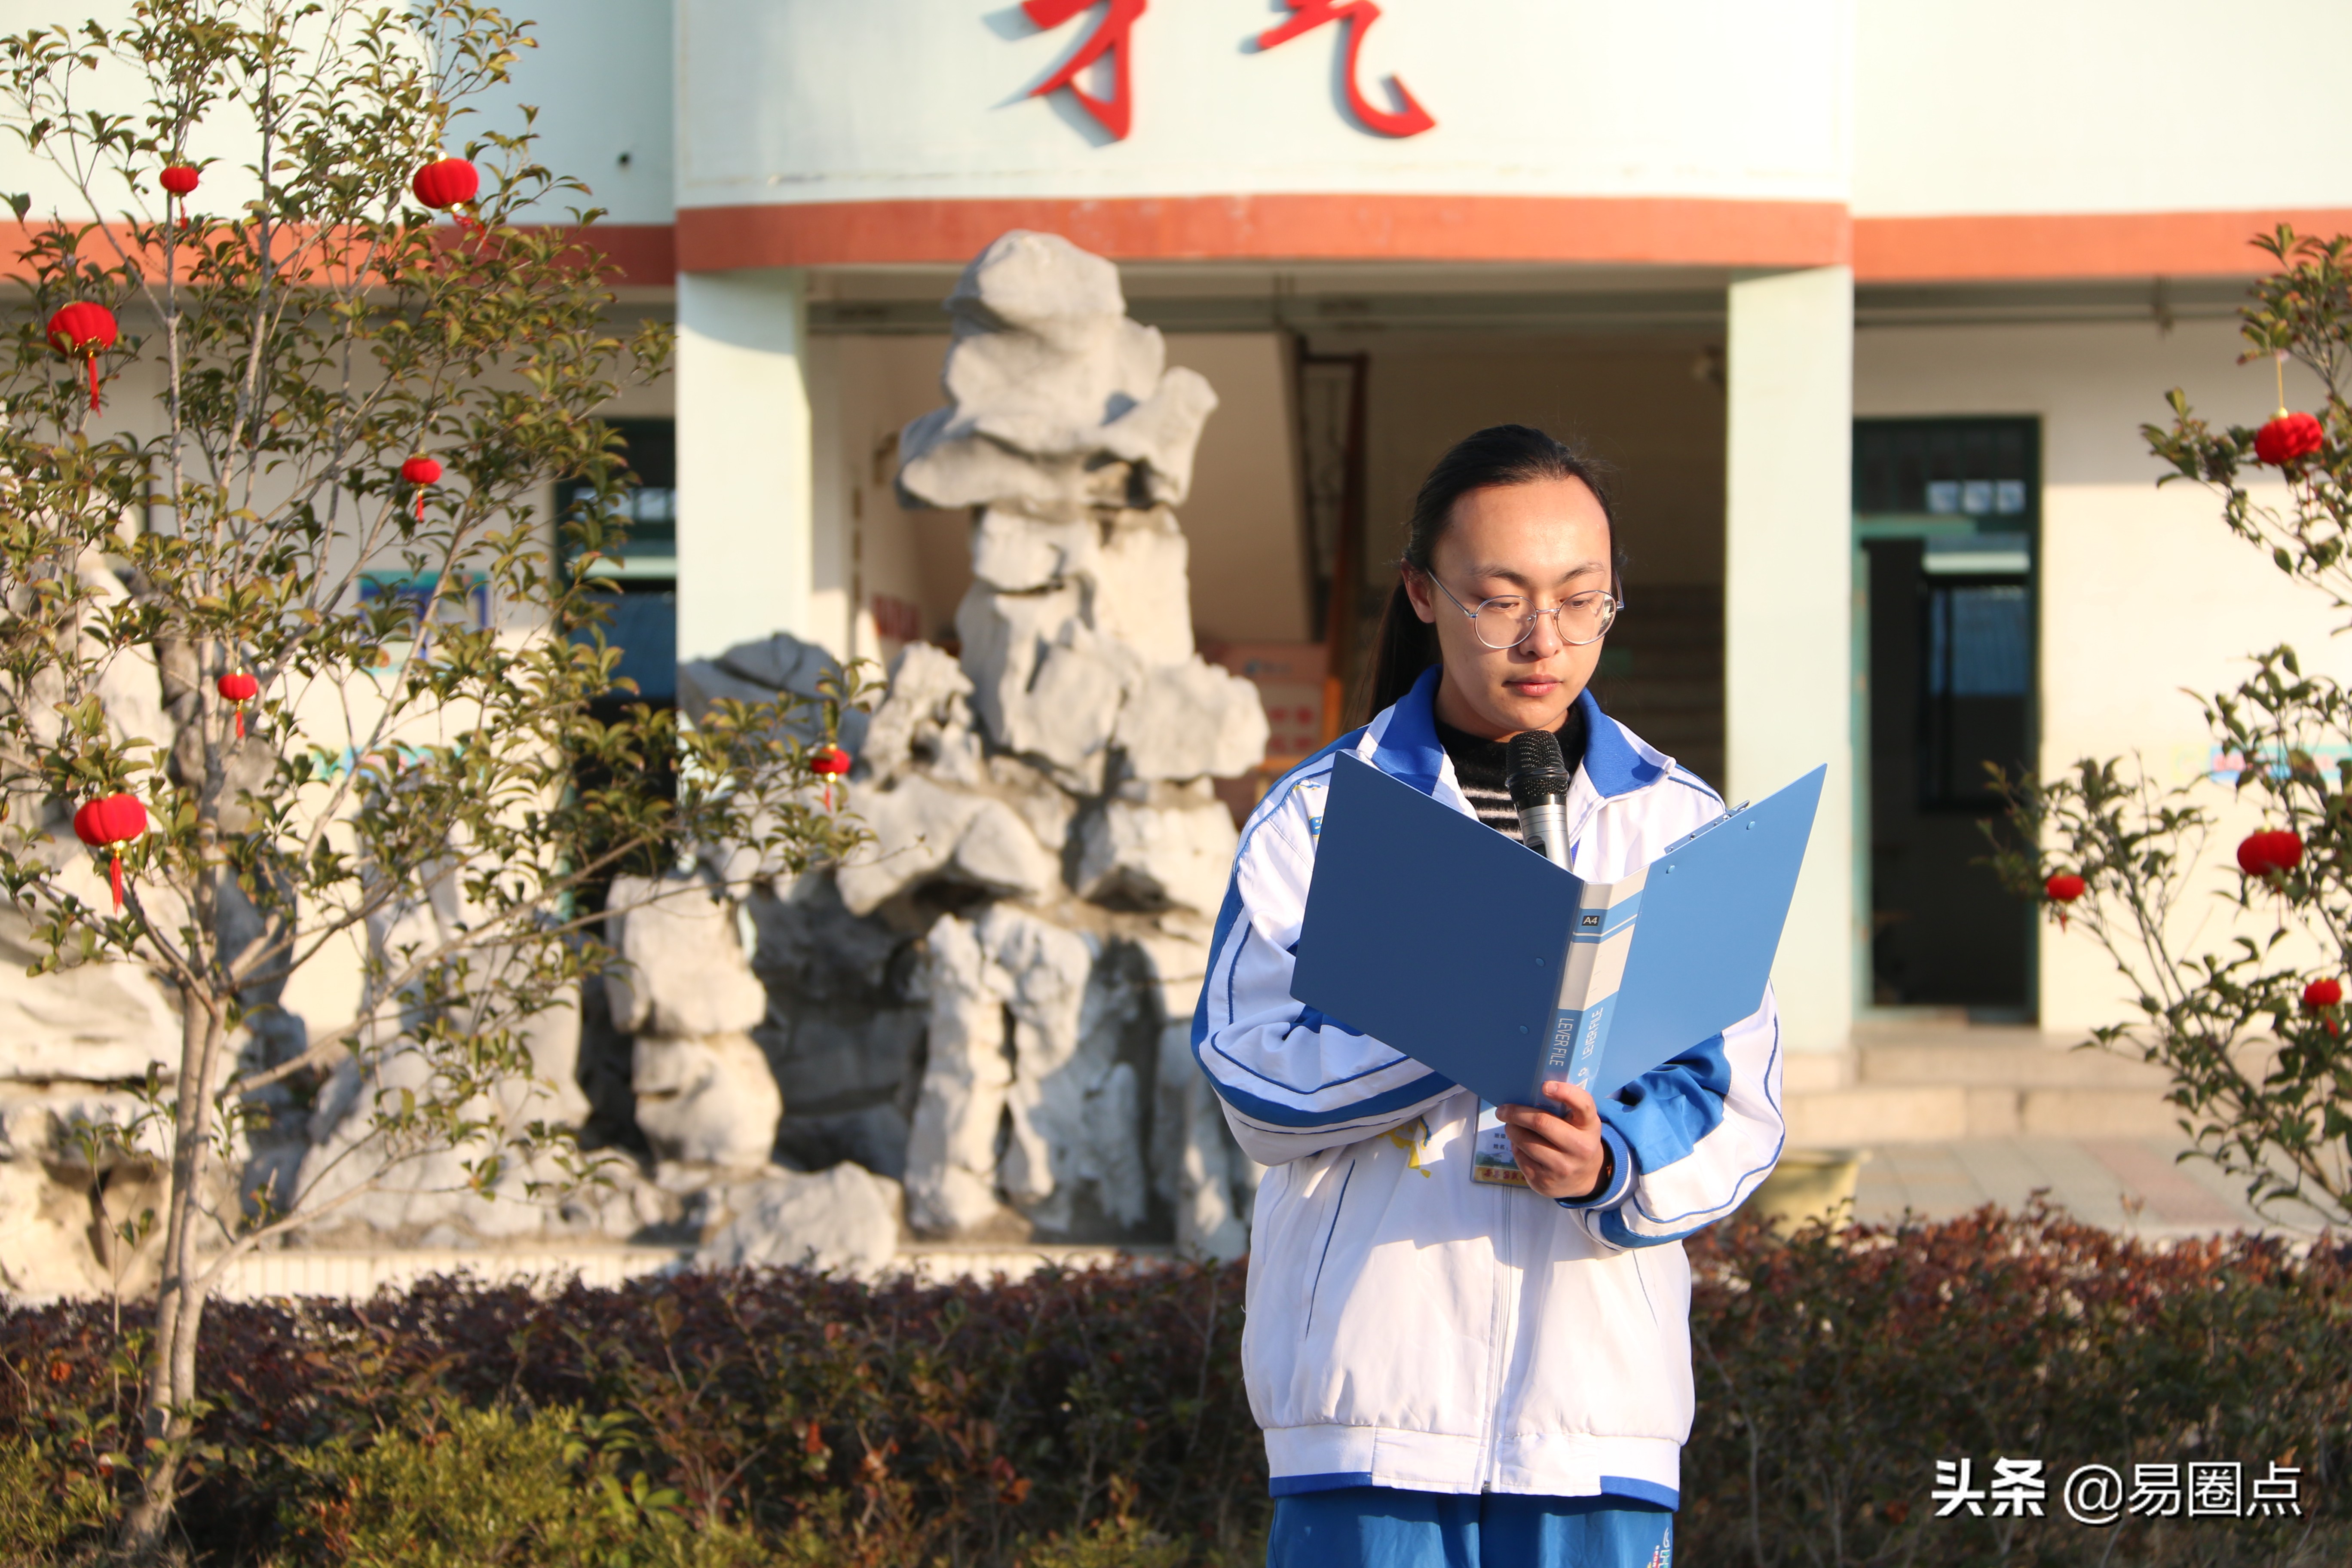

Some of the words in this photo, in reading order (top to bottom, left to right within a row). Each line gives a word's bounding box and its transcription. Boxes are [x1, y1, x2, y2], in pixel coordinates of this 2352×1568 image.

[1589, 1008, 1604, 1030] FILE
[1554, 1018, 1574, 1047] LEVER
[1581, 1027, 1599, 1060] LEVER
[1550, 1048, 1567, 1066] FILE
